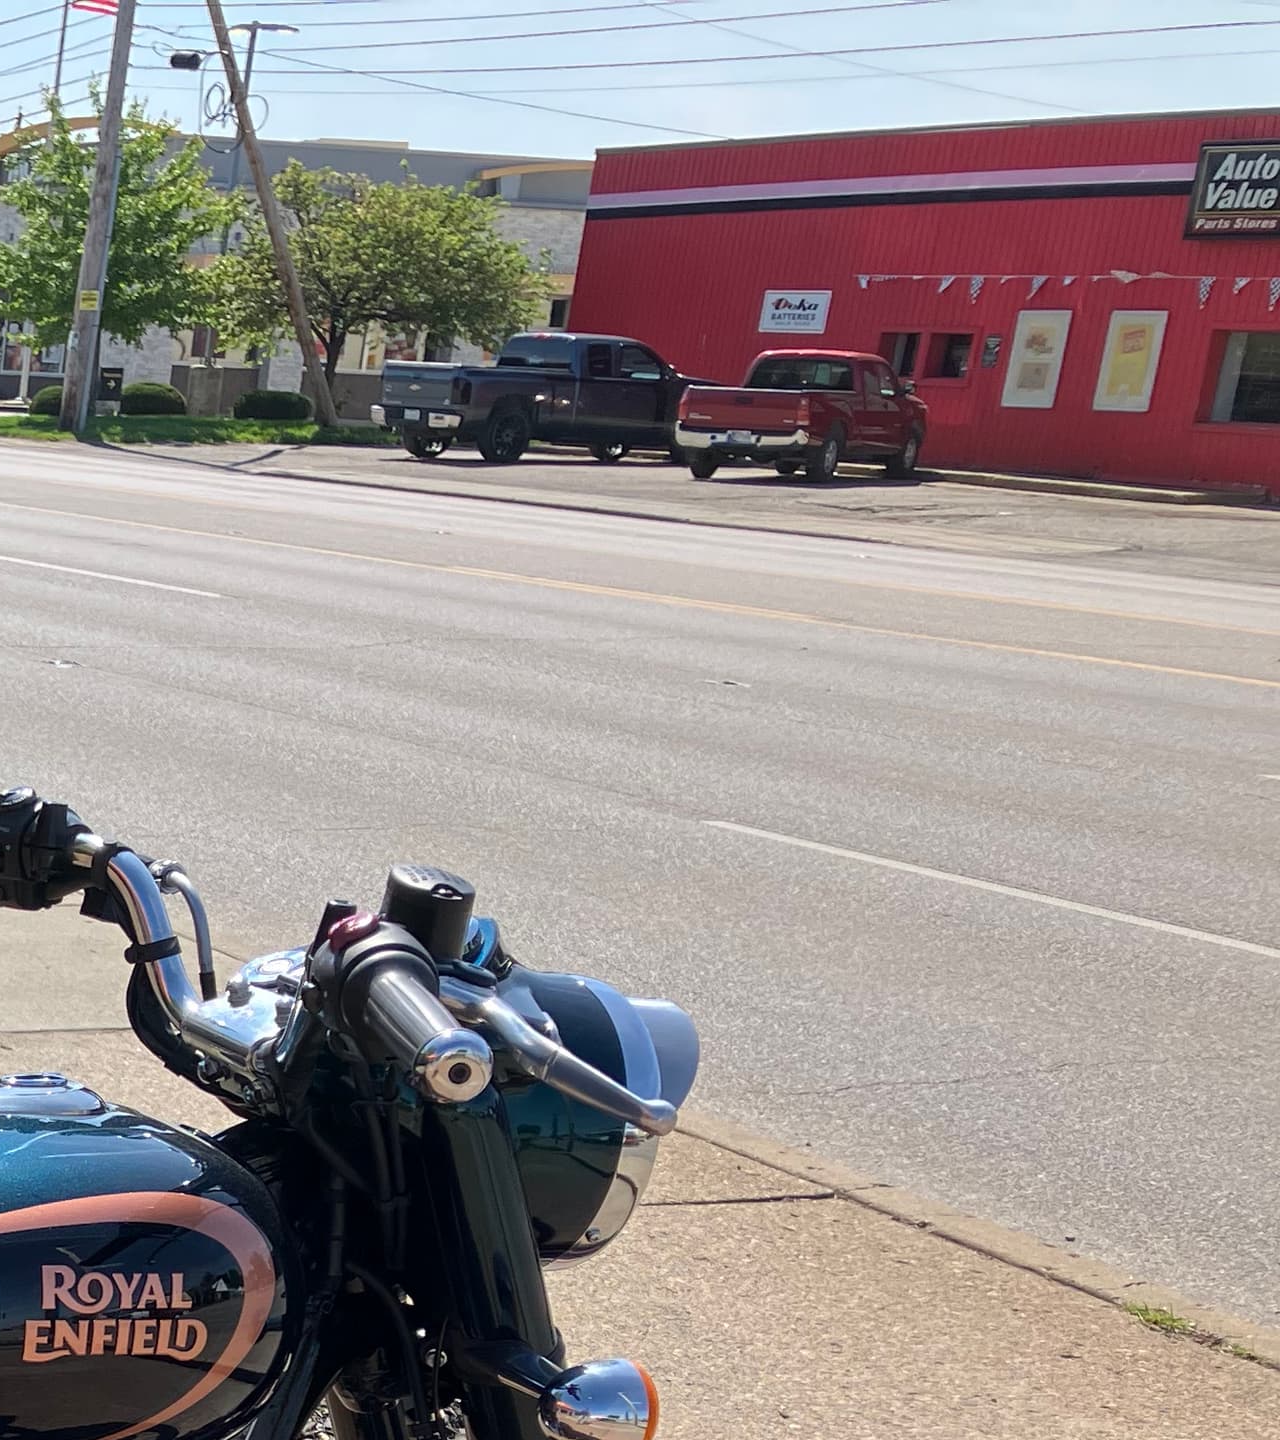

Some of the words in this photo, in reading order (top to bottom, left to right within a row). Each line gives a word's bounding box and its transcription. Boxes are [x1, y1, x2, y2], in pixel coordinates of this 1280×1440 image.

[1213, 152, 1280, 181] Auto
[1204, 182, 1279, 209] Value
[1195, 218, 1231, 229] Parts
[1233, 217, 1278, 229] Stores
[771, 313, 817, 321] BATTERIES
[40, 1264, 193, 1315] ROYAL
[22, 1318, 208, 1363] ENFIELD
